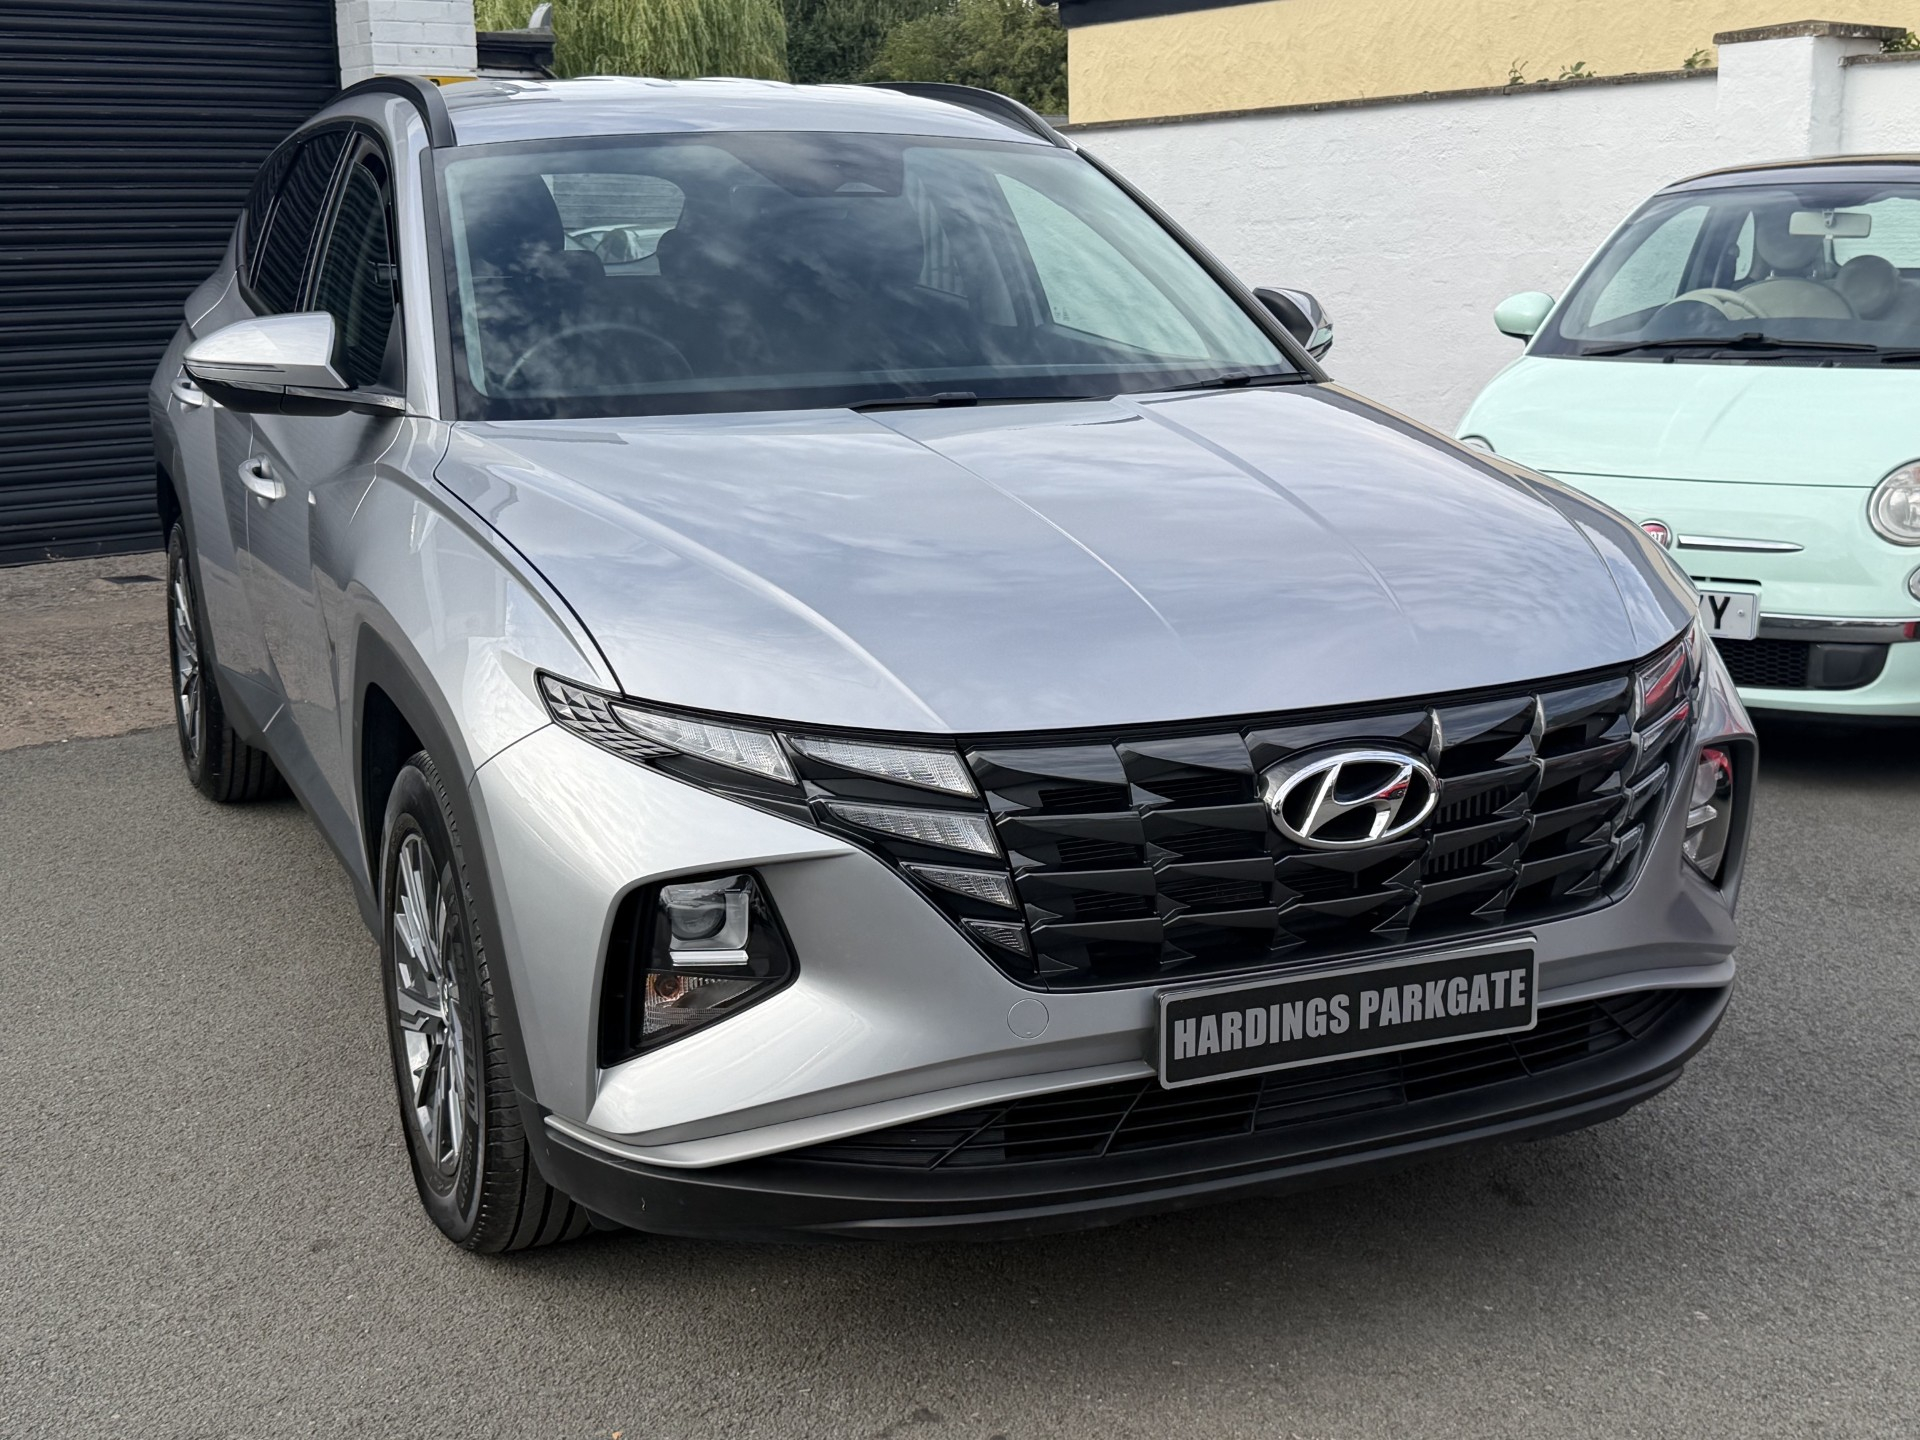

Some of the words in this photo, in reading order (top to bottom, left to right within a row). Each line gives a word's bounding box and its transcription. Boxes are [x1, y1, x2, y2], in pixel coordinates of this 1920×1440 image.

[1699, 594, 1731, 629] Y
[1174, 993, 1350, 1060] HARDINGS
[1359, 969, 1526, 1030] PARKGATE
